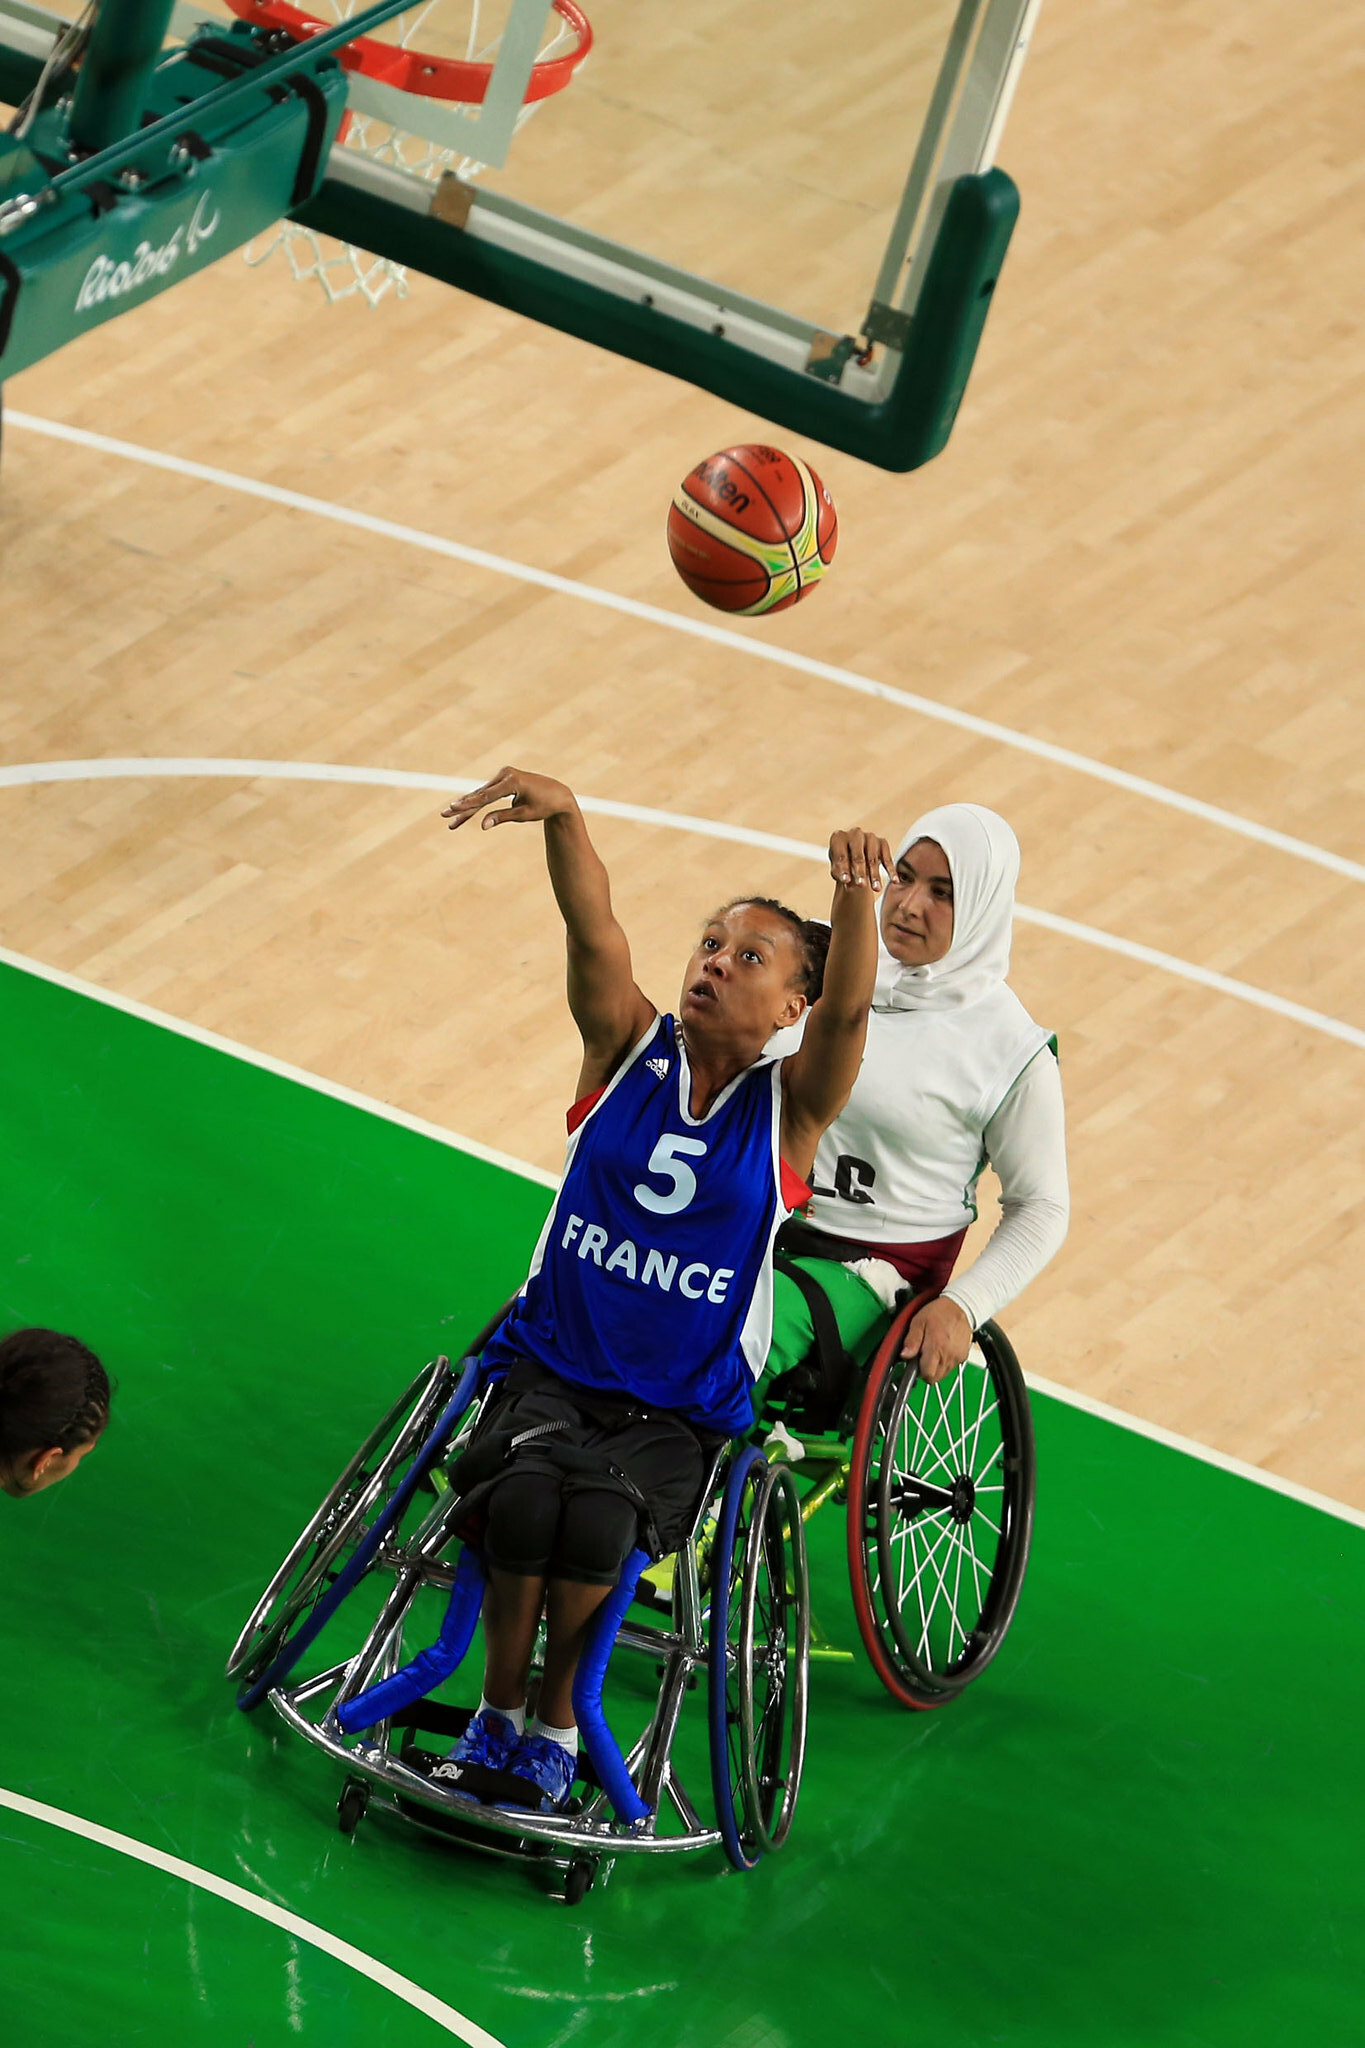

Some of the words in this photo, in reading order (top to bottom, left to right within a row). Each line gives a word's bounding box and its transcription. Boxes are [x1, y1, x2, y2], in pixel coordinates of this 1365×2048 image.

[645, 1059, 666, 1081] adida
[633, 1132, 708, 1215] 5
[561, 1213, 735, 1304] FRANCE
